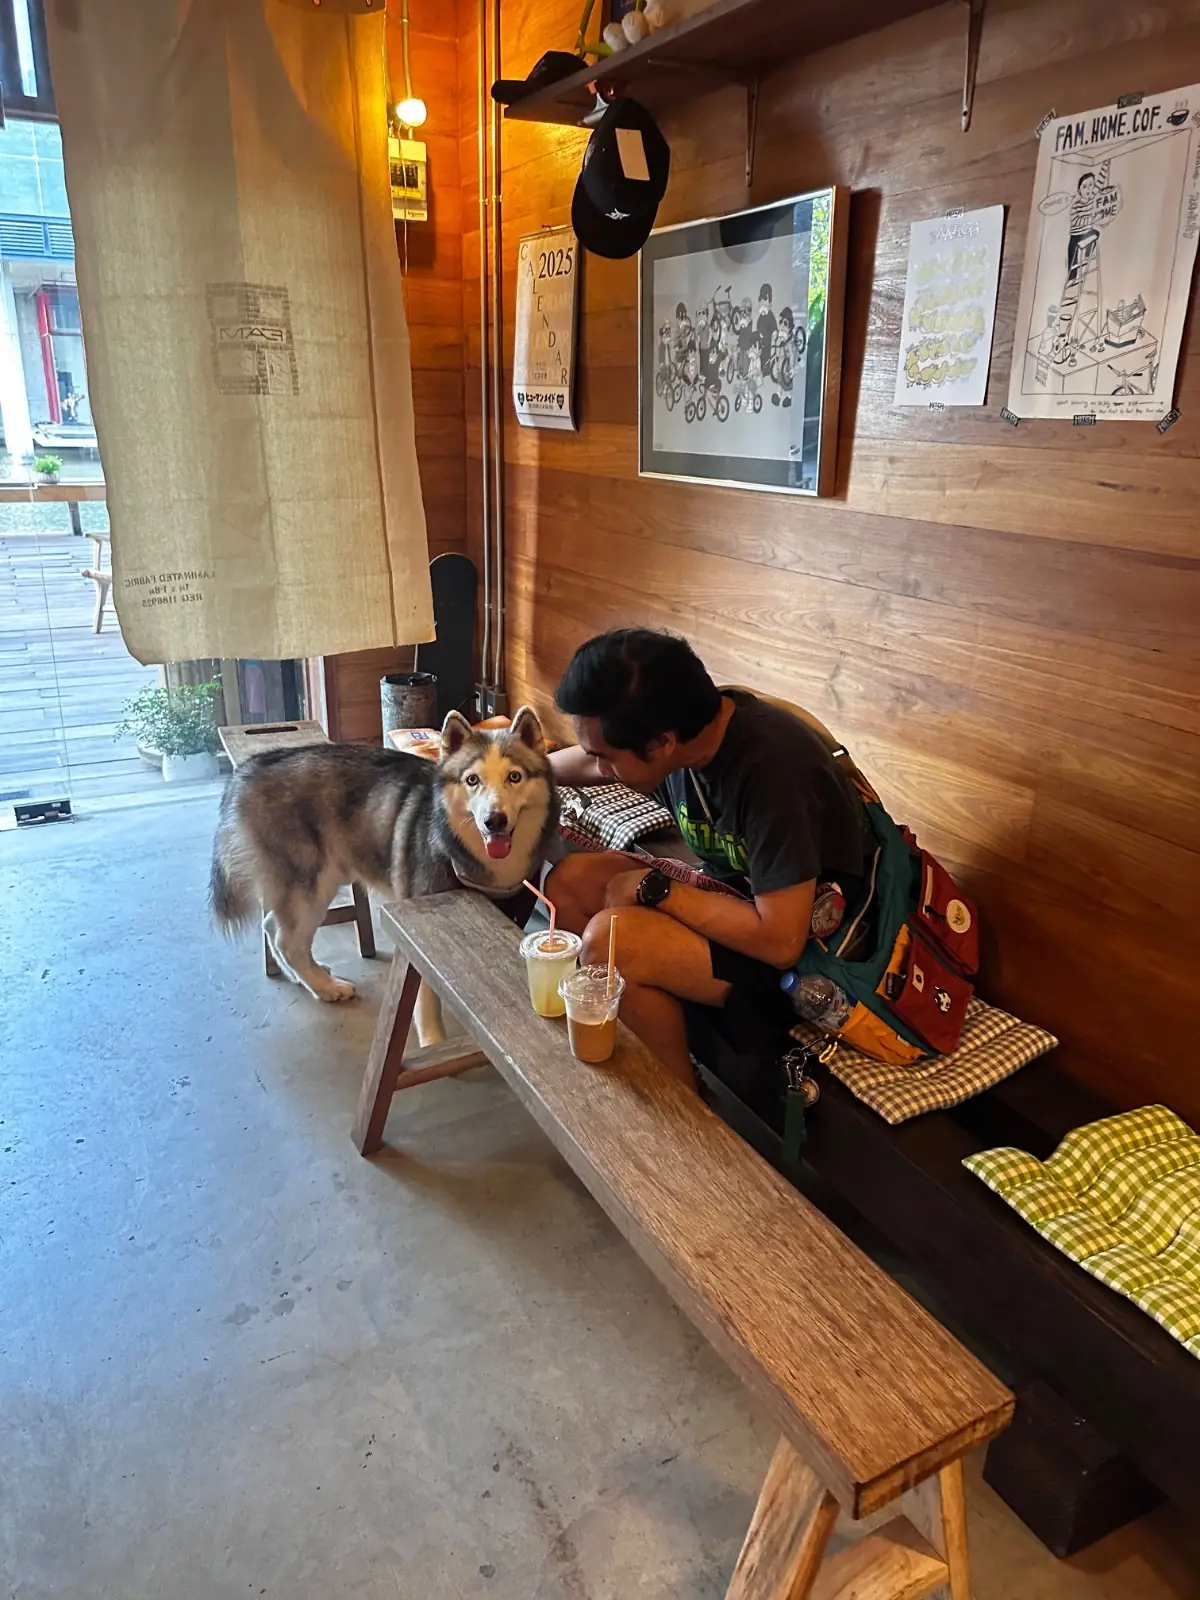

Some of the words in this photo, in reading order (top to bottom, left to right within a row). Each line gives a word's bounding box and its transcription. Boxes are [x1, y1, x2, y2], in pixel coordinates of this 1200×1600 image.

[1096, 192, 1118, 208] FAM
[538, 247, 573, 278] 2025
[1073, 414, 1097, 426] HITCH
